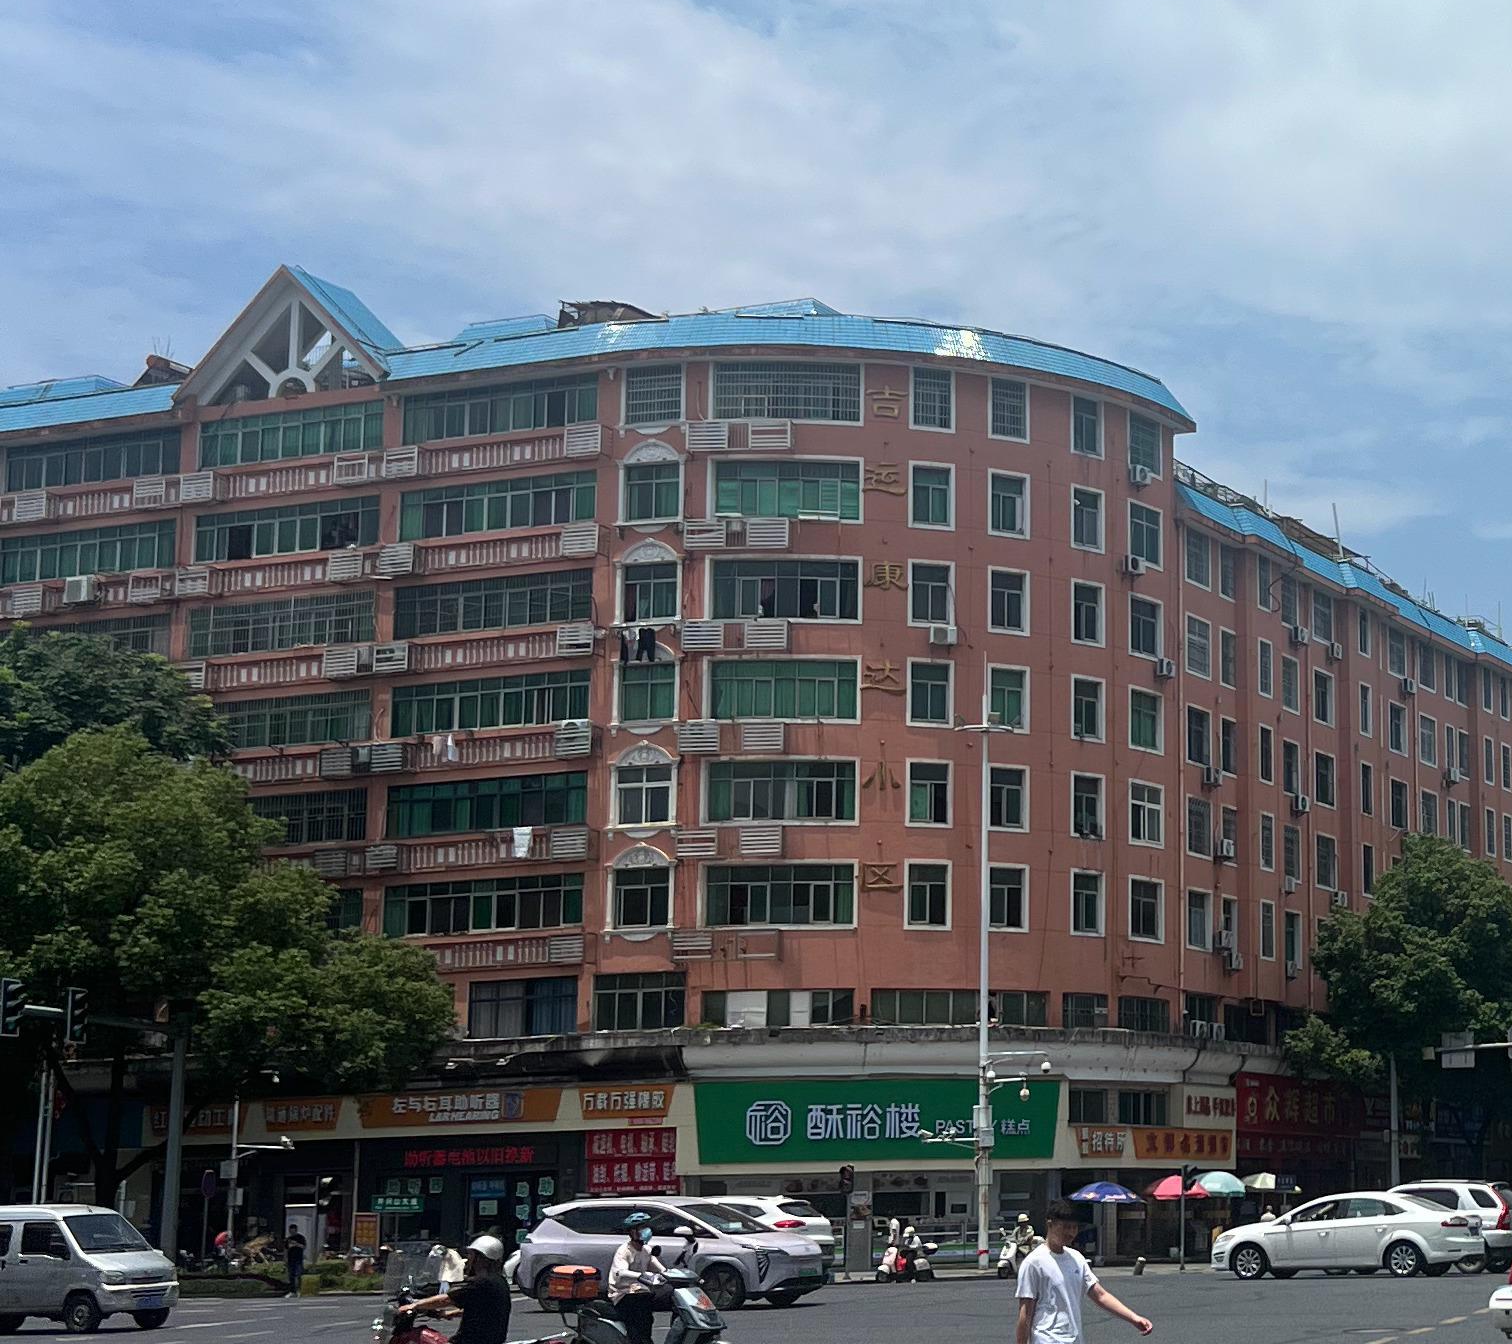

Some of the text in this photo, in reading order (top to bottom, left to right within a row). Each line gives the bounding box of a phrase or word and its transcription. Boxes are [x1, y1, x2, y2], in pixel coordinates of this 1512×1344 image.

[861, 384, 908, 891] 吉运康达小区
[807, 1103, 921, 1140] 酥裕楼
[1000, 1118, 1031, 1136] 糕点
